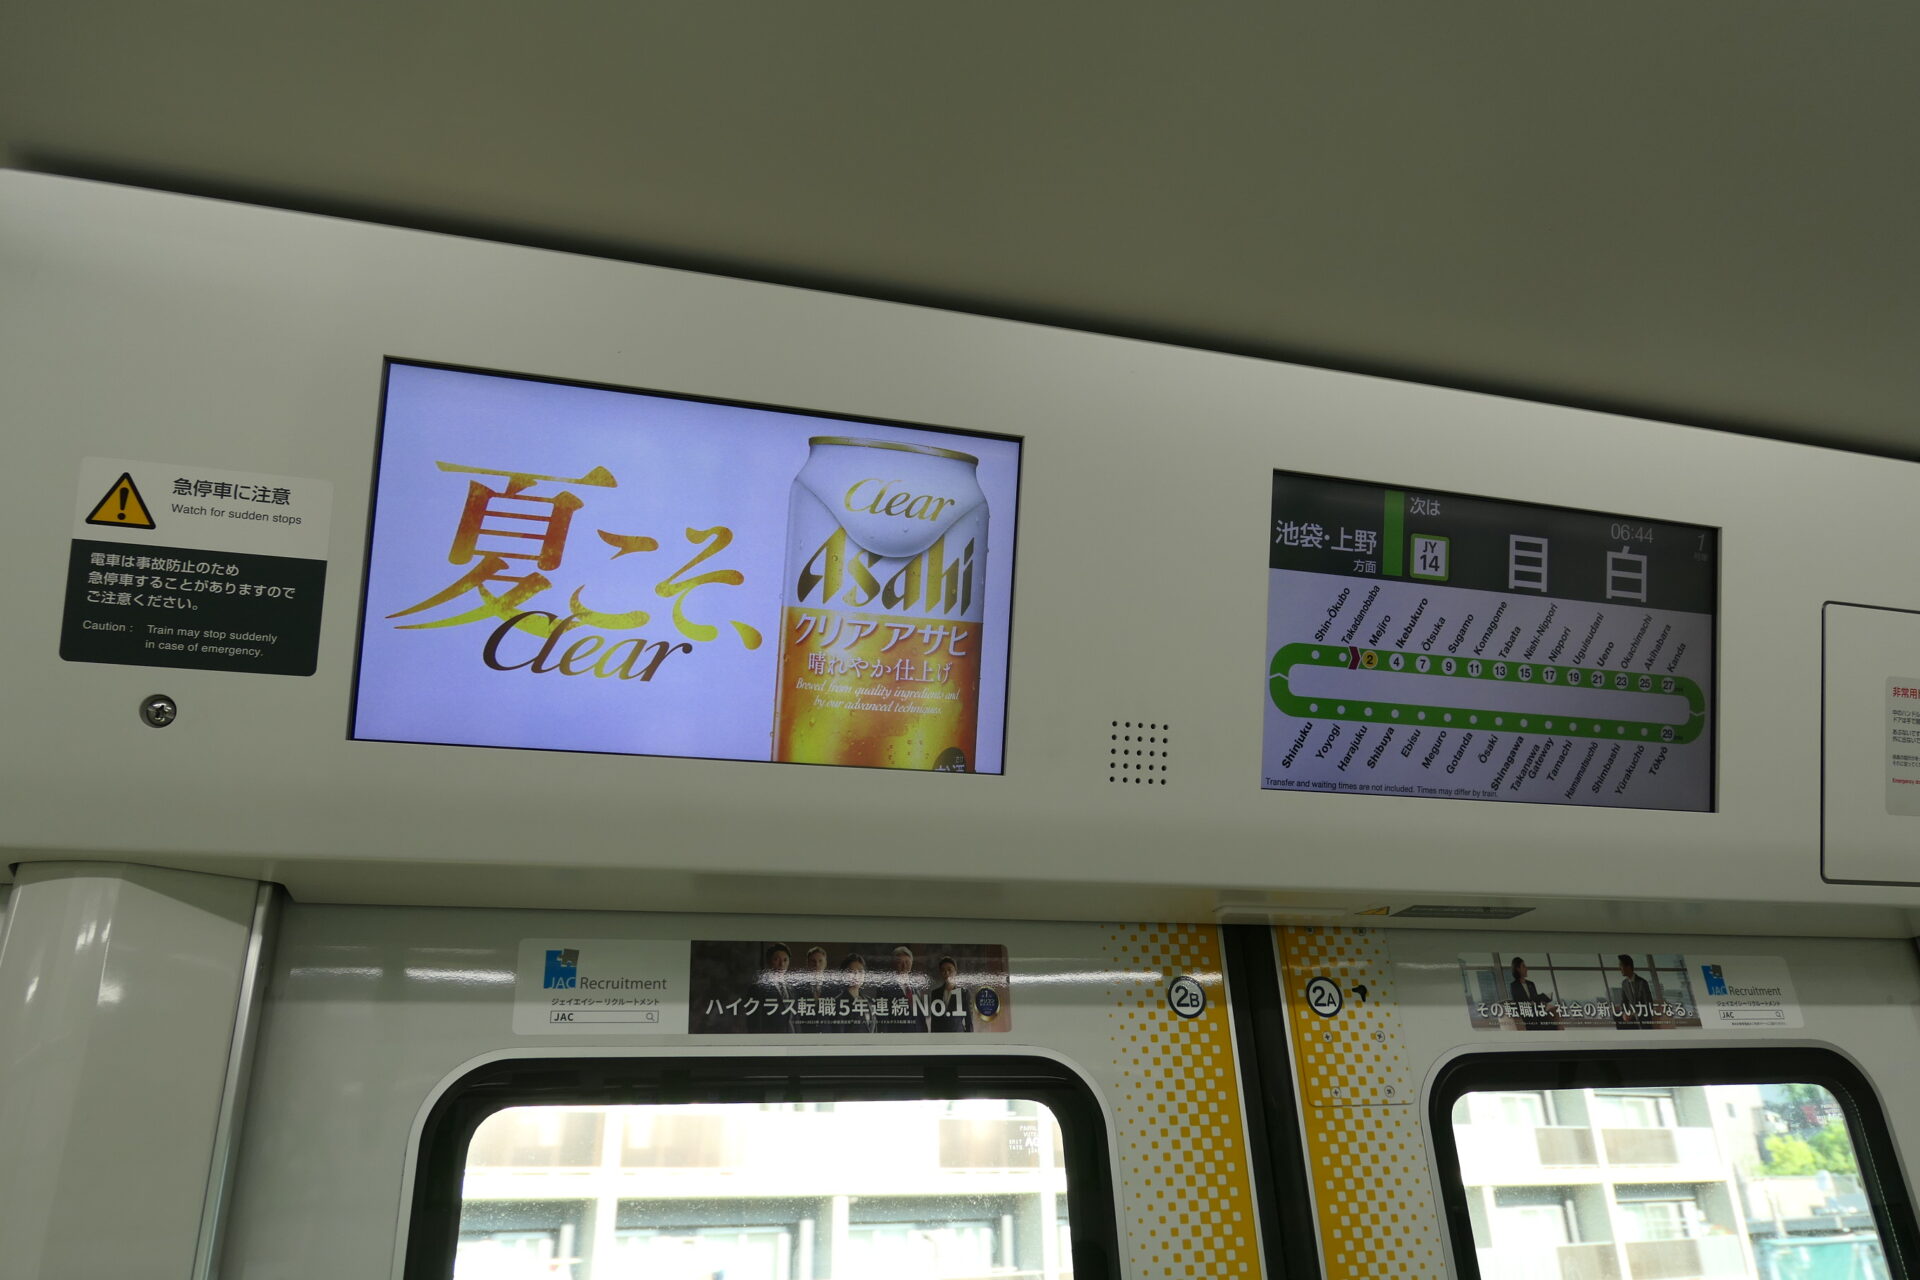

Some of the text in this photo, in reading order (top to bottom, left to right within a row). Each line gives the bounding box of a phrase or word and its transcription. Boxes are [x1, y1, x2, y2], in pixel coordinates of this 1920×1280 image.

[172, 478, 291, 506] 急停車に注意
[844, 478, 955, 522] Clear
[171, 503, 302, 526] Watch for sudden stops
[1410, 497, 1441, 516] 次は
[1275, 519, 1377, 555] 池袋・上野
[1610, 523, 1654, 544] 06:44
[1422, 541, 1437, 553] JY
[89, 552, 240, 577] 電車は事故防止のため
[797, 526, 975, 616] Asahi
[1353, 560, 1376, 574] 方面
[1419, 555, 1440, 572] 14
[88, 571, 296, 600] 急停車することがありますので
[86, 590, 199, 611] ご注意ください。
[1314, 586, 1351, 642] Shin-Ōkubo
[1340, 584, 1381, 645] Takadanobaba
[1395, 597, 1428, 649] Ikebukuro
[147, 624, 278, 644] Train may stop suddenly
[1368, 613, 1391, 647] Mejiro
[1448, 613, 1474, 655] Sugamo
[1473, 600, 1508, 656] Komagome
[1523, 603, 1558, 660] Nishi-Nippori
[1572, 611, 1604, 666] Uguisudani
[145, 640, 264, 657] in case of emergency.
[482, 610, 693, 682] Clear
[1498, 625, 1522, 660] Tabata
[1549, 626, 1572, 663] Nippori
[1620, 613, 1653, 670] Okachimachi
[1643, 623, 1672, 671] Akihabara
[1366, 655, 1374, 665] 2
[1393, 657, 1400, 667] 4
[1420, 660, 1427, 670] 7
[1445, 661, 1453, 671] 9
[1597, 641, 1615, 668] Ueno
[1666, 642, 1687, 673] Kanda
[808, 651, 953, 685] 晴れやか仕上げ
[1469, 663, 1480, 674] 11
[1494, 666, 1506, 677] 13
[1519, 668, 1531, 679] 15
[1545, 670, 1556, 681] 17
[1569, 672, 1580, 683] 19
[1592, 674, 1603, 685] 21
[796, 677, 825, 692] Brewed
[827, 680, 851, 695] from
[854, 683, 891, 699] quality
[944, 687, 960, 701] and
[1616, 676, 1628, 687] 23
[1639, 678, 1651, 689] 25
[1663, 680, 1674, 690] 27
[813, 695, 826, 707] by
[826, 699, 844, 709] our
[844, 698, 892, 713] advanced
[1281, 721, 1313, 769] Shinjuku
[1315, 723, 1341, 760] Yoyogi
[1401, 729, 1422, 758] Ebisu
[1662, 728, 1673, 739] 29
[1337, 725, 1368, 772] Harajuku
[1366, 726, 1395, 770] Shibuya
[1421, 730, 1447, 770] Meguro
[1446, 731, 1473, 775] Gotanda
[1528, 736, 1555, 780] Gateway
[1490, 735, 1525, 792] Shinagawa
[1510, 743, 1541, 793] Takanawa
[1546, 739, 1573, 783] Tamachi
[1591, 742, 1621, 794] Shimbashi
[1265, 777, 1295, 787] Transfer
[1296, 779, 1310, 788] and
[1311, 781, 1337, 791] waiting
[1338, 782, 1358, 790] times
[1370, 783, 1383, 791] not
[1384, 784, 1414, 793] included.
[1416, 786, 1437, 794] Times
[1438, 788, 1452, 796] may
[1453, 787, 1471, 796] differ
[1472, 788, 1481, 797] by
[551, 976, 667, 990] JAC Recruitment
[1728, 985, 1781, 996] Recruitment
[1174, 985, 1200, 1008] 2B
[1312, 985, 1337, 1008] 2A
[554, 1013, 574, 1021] JAC
[1477, 1001, 1694, 1018] その転職は、社会の新しい力になる。
[1722, 1011, 1734, 1019] JAC
